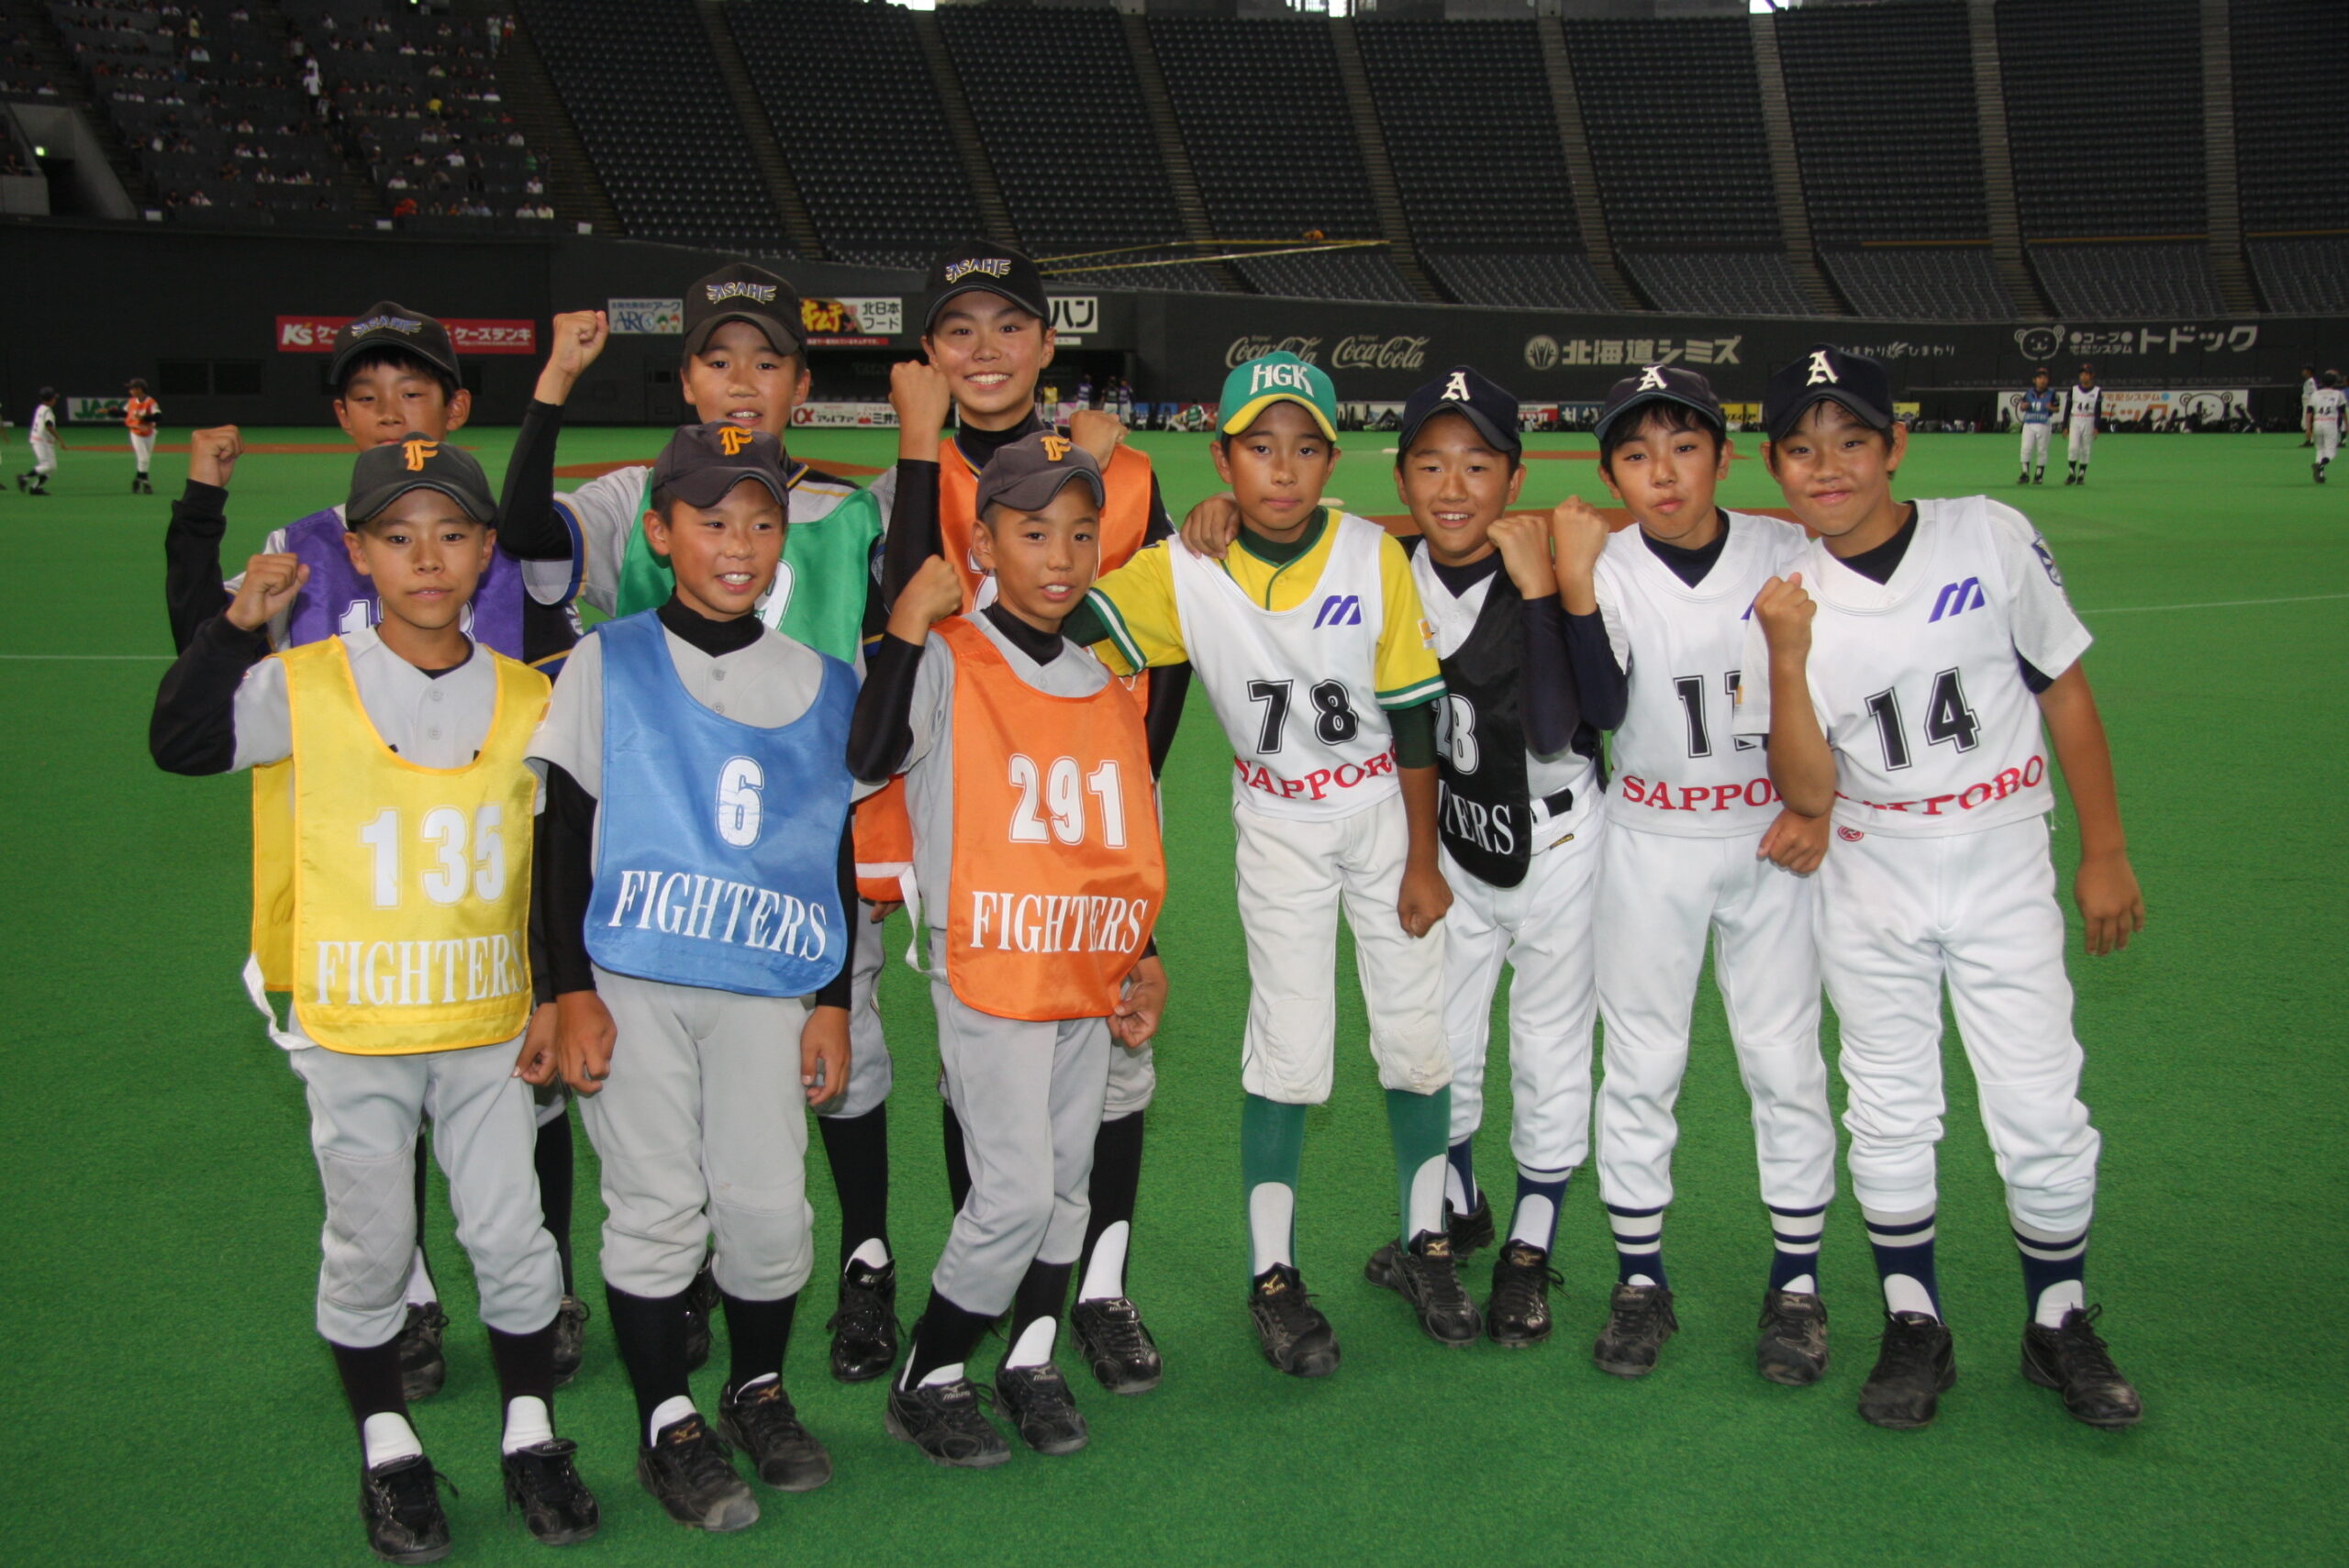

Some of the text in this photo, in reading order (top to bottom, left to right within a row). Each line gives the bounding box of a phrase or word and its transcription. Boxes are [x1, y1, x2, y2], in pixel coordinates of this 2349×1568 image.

[863, 301, 900, 316] 北日本
[863, 317, 900, 329] フード
[455, 328, 531, 340] ケーズデンキ
[1562, 335, 1742, 365] 北海道シミズ
[2069, 344, 2132, 355] 宅配システム
[2139, 326, 2258, 354] トドック
[1249, 363, 1315, 398] HGK
[1440, 371, 1472, 402] A
[1636, 364, 1668, 392] A
[1806, 350, 1840, 387] A
[1247, 679, 1359, 755] 78
[1865, 666, 1981, 772] 14
[715, 755, 764, 851] 6
[1008, 753, 1127, 849] 291
[1622, 774, 1784, 812] SAPPO
[1444, 783, 1515, 856] TERS
[359, 802, 507, 910] 135
[608, 869, 828, 962] FIGHTERS
[970, 890, 1149, 954] FIGHTERS
[316, 929, 527, 1006] FIGHTERS
